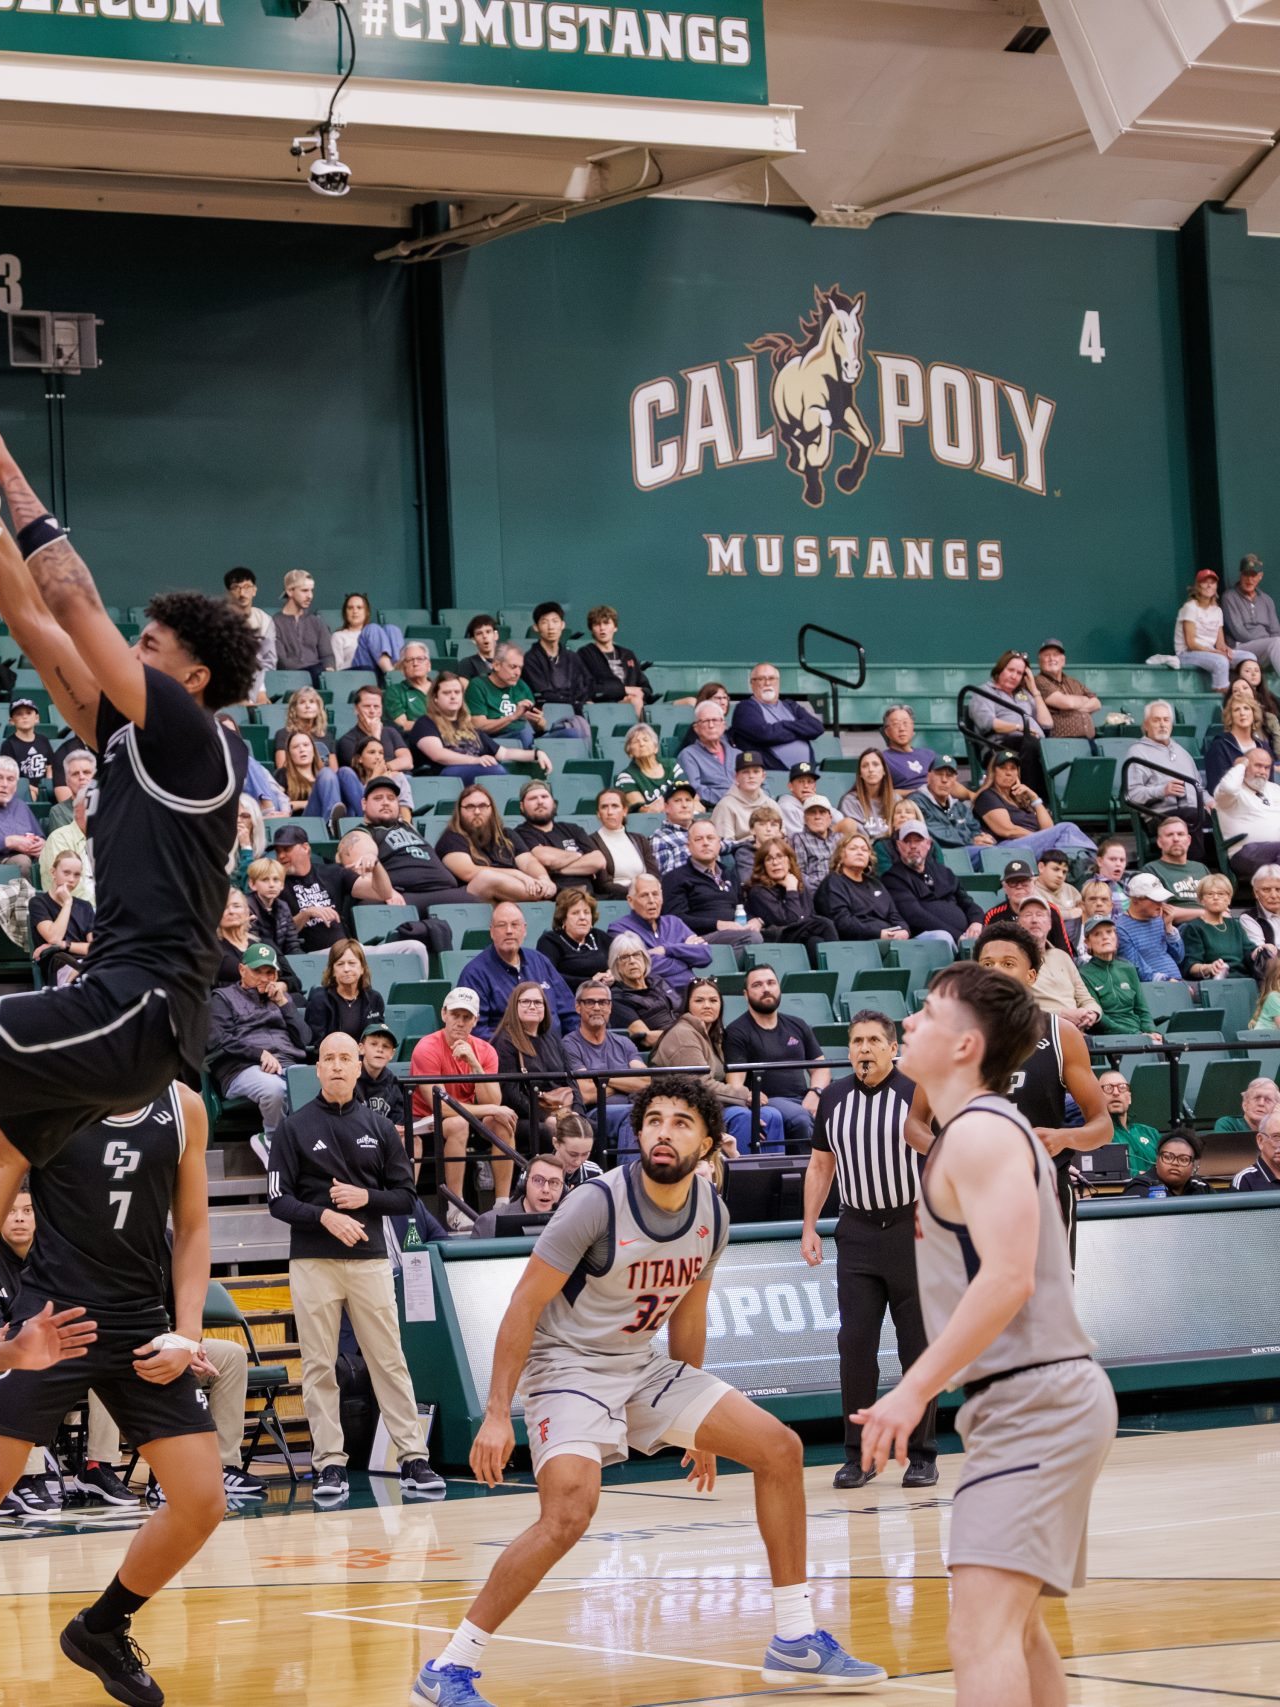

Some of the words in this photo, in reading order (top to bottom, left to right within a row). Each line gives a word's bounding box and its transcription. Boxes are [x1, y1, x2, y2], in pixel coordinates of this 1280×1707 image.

[361, 0, 751, 66] #CPMUSTANGS
[1079, 310, 1106, 363] 4
[630, 356, 777, 491] CAL
[868, 350, 1056, 496] POLY
[702, 533, 1004, 581] MUSTANGS
[109, 1190, 132, 1230] 7
[625, 1256, 703, 1291] TITANS
[742, 1387, 788, 1397] AKTRONICS
[537, 1416, 551, 1445] F
